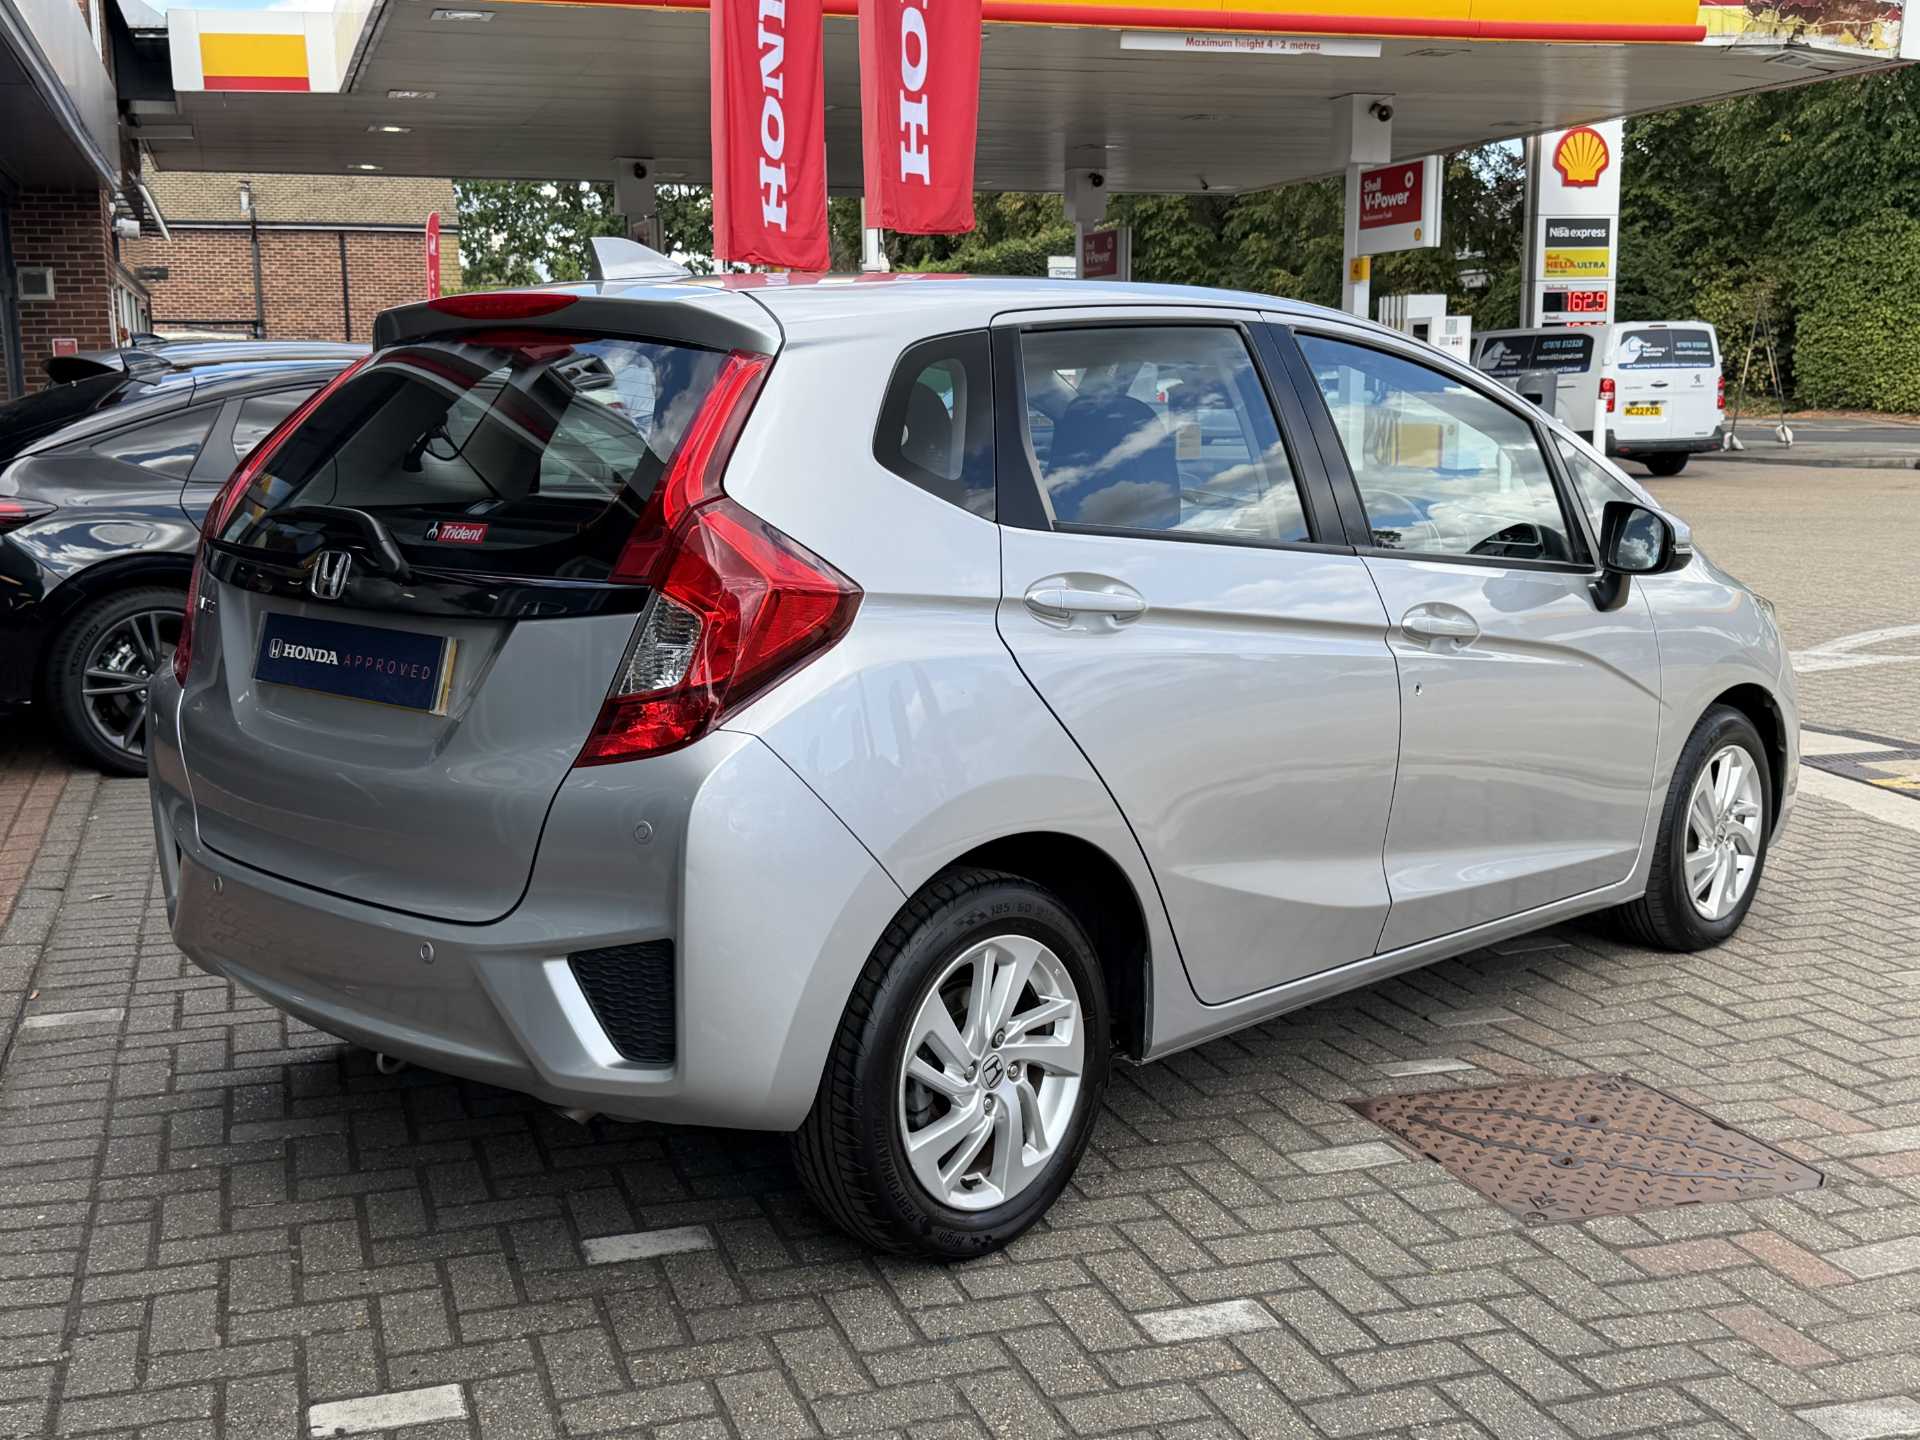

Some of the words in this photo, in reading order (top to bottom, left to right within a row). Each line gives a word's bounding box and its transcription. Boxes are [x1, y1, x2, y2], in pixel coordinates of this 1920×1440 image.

[1185, 36, 1233, 48] Maximum
[1234, 38, 1265, 50] height
[1289, 41, 1321, 50] metres
[1364, 176, 1382, 192] Shell
[1364, 191, 1410, 211] V-Power
[1549, 227, 1570, 238] Nisa
[1570, 228, 1607, 239] express
[1577, 261, 1606, 269] ULTRA
[1567, 291, 1607, 312] 162.9
[440, 524, 484, 541] Trident
[282, 643, 339, 666] HONDA
[343, 654, 432, 681] APPROVED
